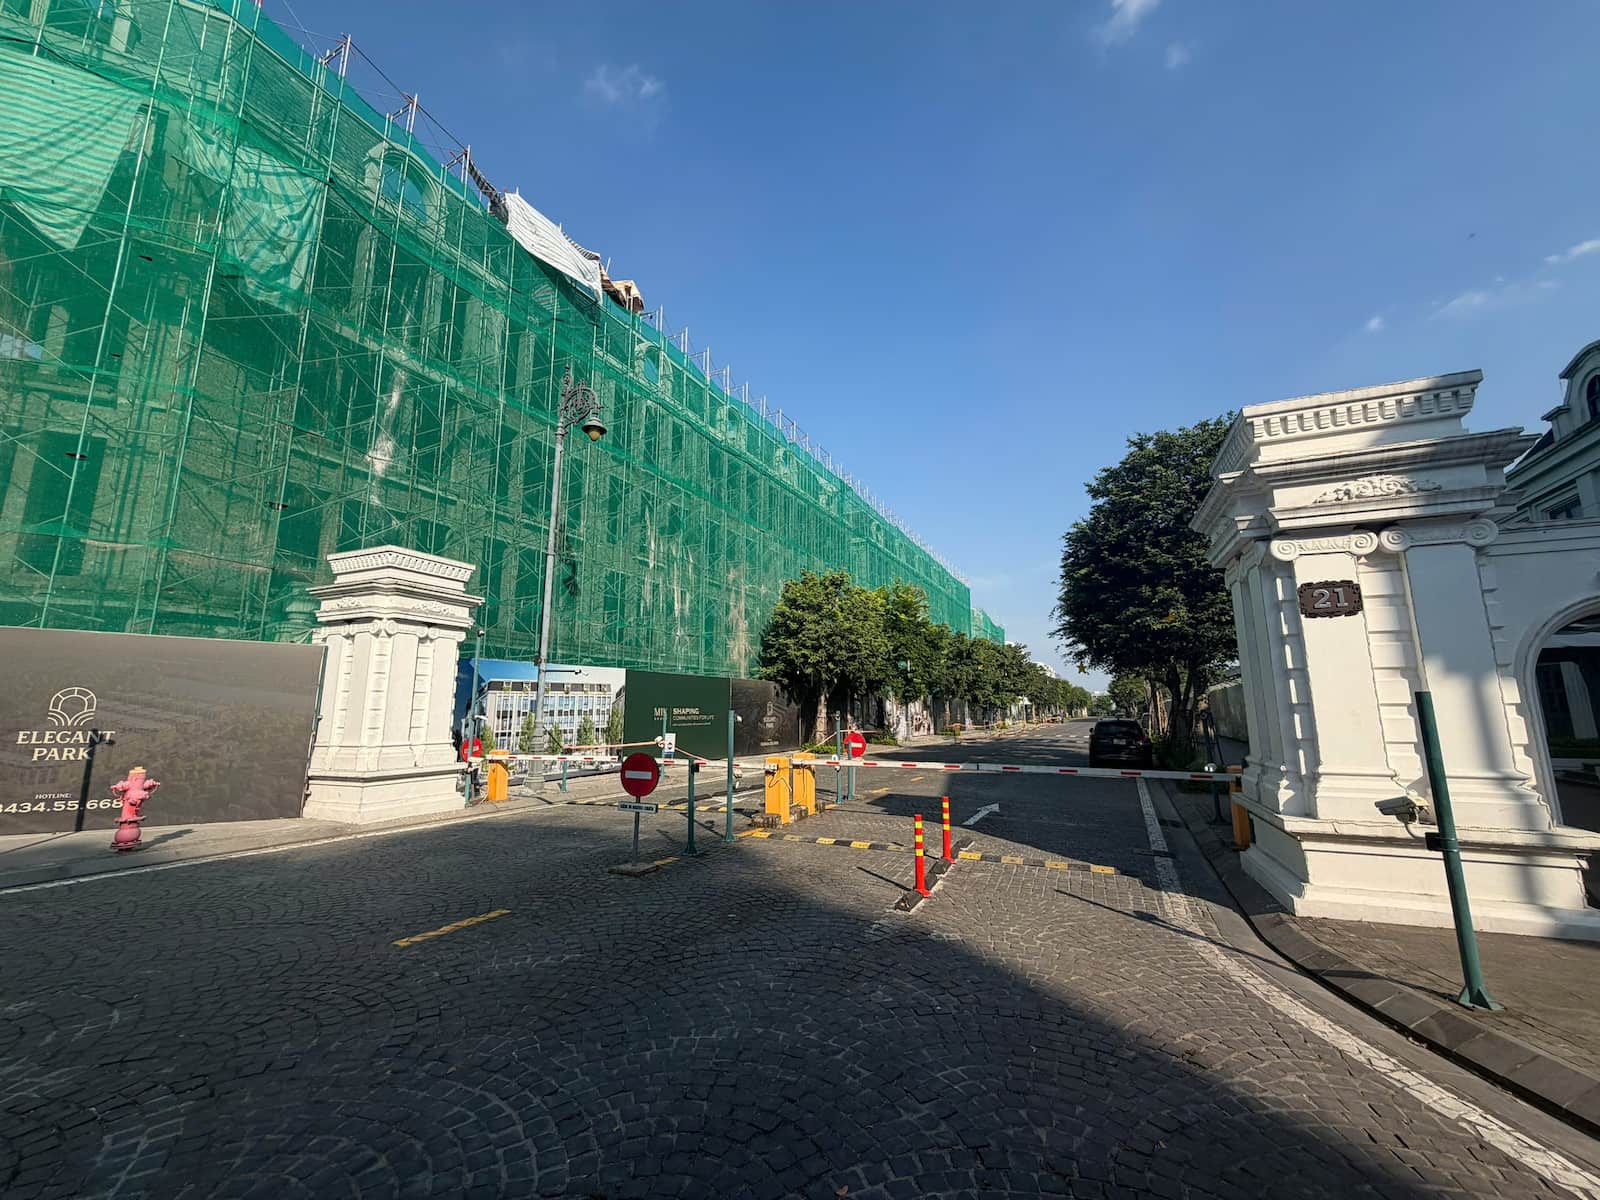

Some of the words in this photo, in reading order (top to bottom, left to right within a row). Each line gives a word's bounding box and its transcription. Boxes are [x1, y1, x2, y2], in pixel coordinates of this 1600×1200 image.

[1312, 587, 1349, 609] 21
[672, 707, 700, 715] SHAPING
[16, 730, 116, 744] ELEGANT
[31, 747, 93, 761] PARK
